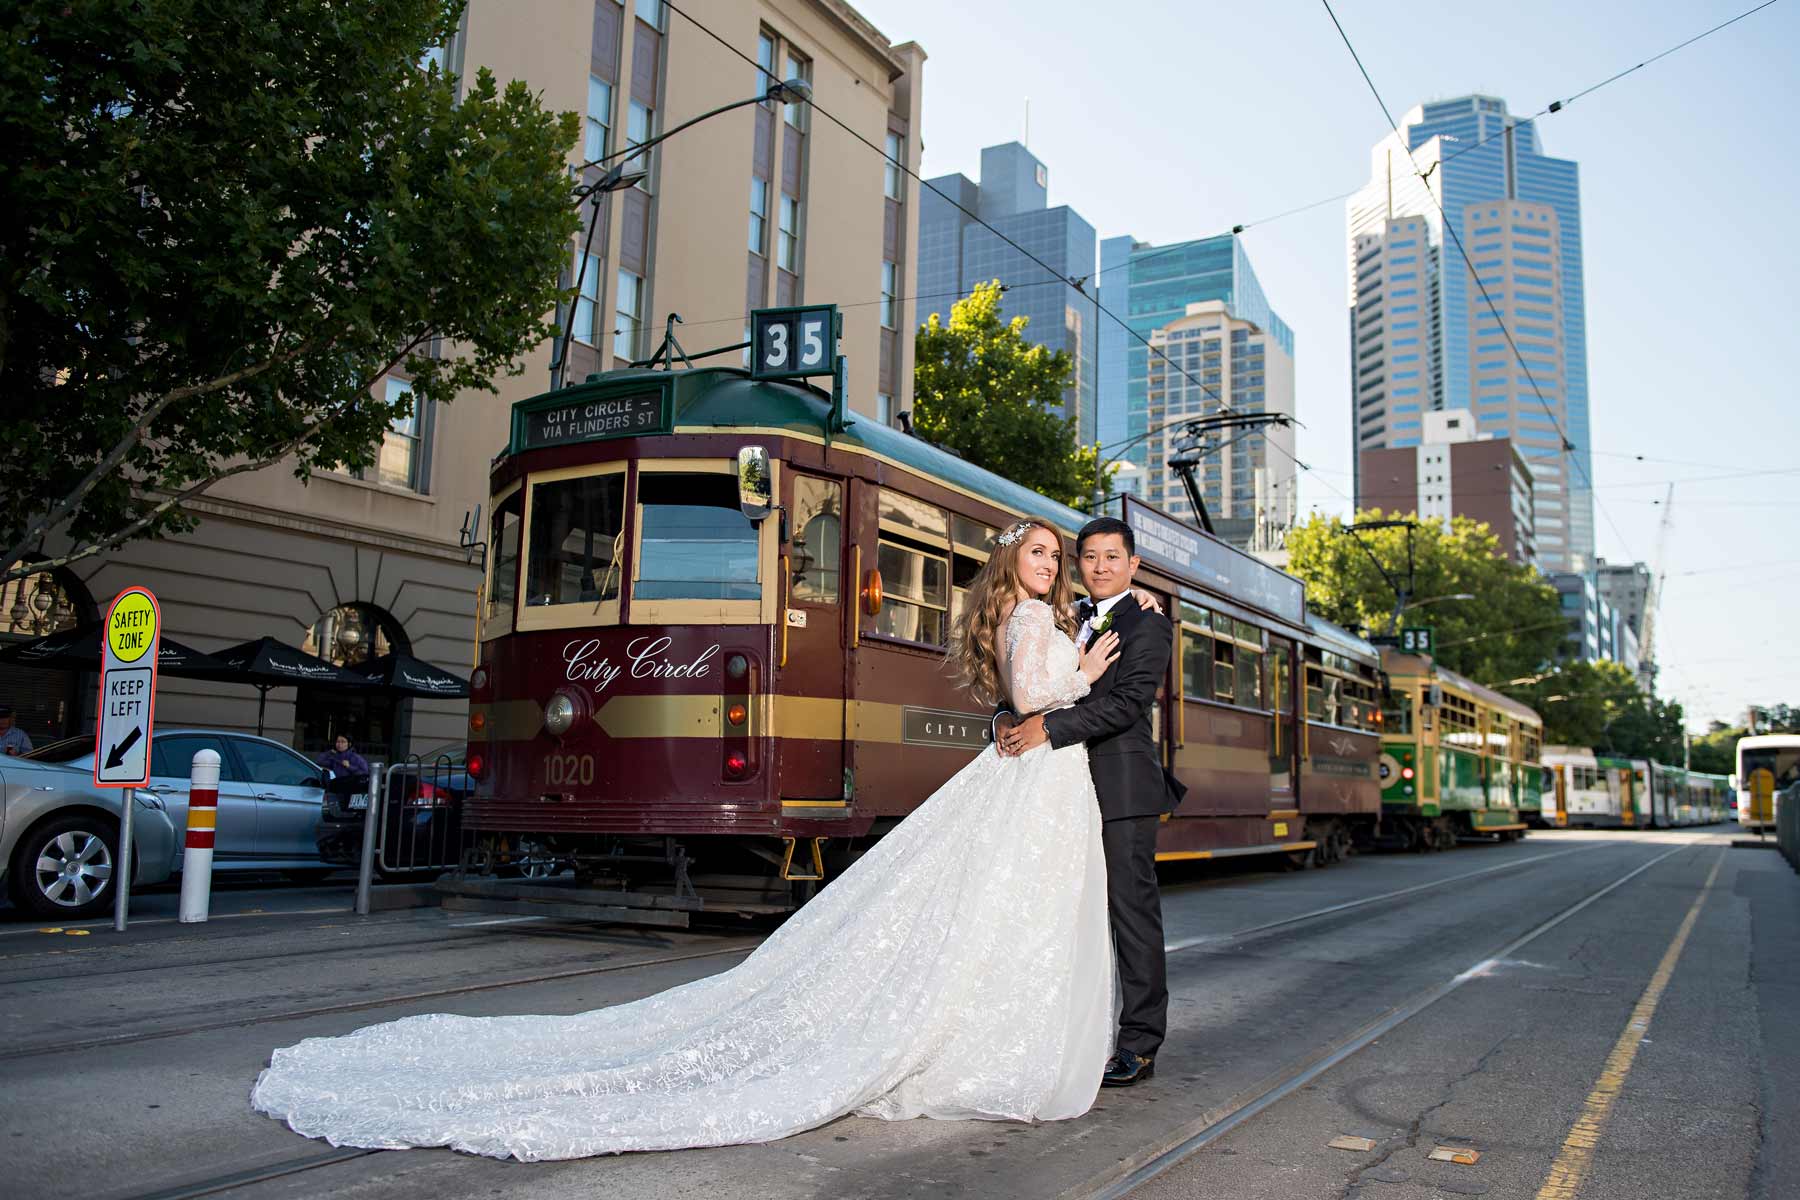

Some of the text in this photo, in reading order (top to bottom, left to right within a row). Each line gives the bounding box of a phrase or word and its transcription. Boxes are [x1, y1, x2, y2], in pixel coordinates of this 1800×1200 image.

[766, 321, 822, 367] 35
[547, 408, 578, 424] CITY
[585, 399, 633, 418] CIRCLE
[543, 411, 654, 439] VIA FLINDERS ST
[114, 609, 151, 629] SAFETY
[118, 631, 144, 650] ZONE
[1404, 631, 1429, 649] 35
[563, 636, 720, 693] City Circle
[111, 680, 144, 696] KEEP
[111, 700, 142, 717] LEFT
[925, 722, 968, 737] CITY
[543, 754, 594, 786] 1020
